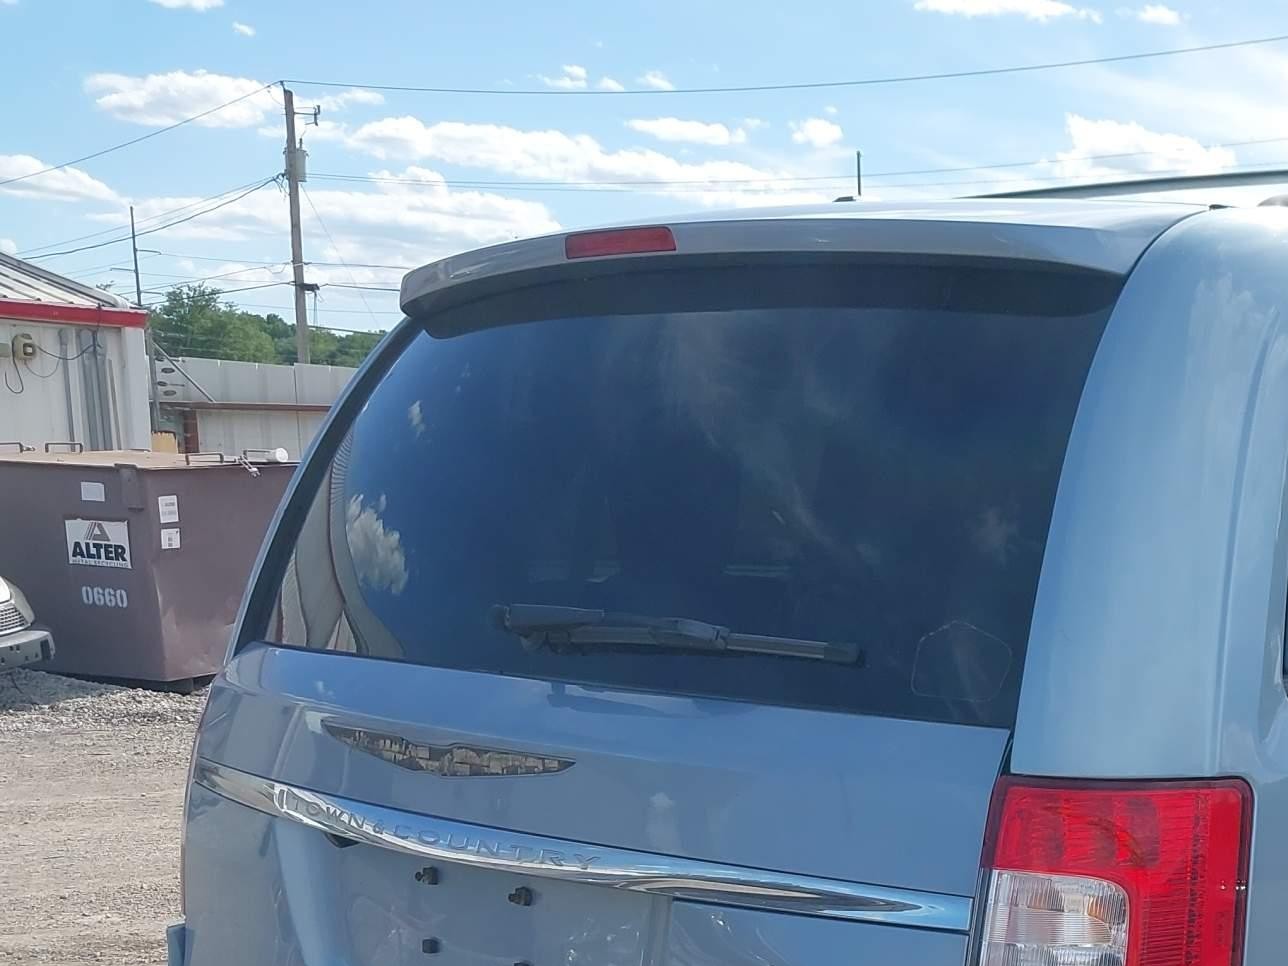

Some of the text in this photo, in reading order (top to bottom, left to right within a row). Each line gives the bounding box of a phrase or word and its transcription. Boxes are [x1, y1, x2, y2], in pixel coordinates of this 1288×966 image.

[71, 541, 127, 562] ALTER
[81, 586, 128, 608] 0660
[292, 794, 366, 829] TOWN
[392, 824, 601, 870] COUNTRY
